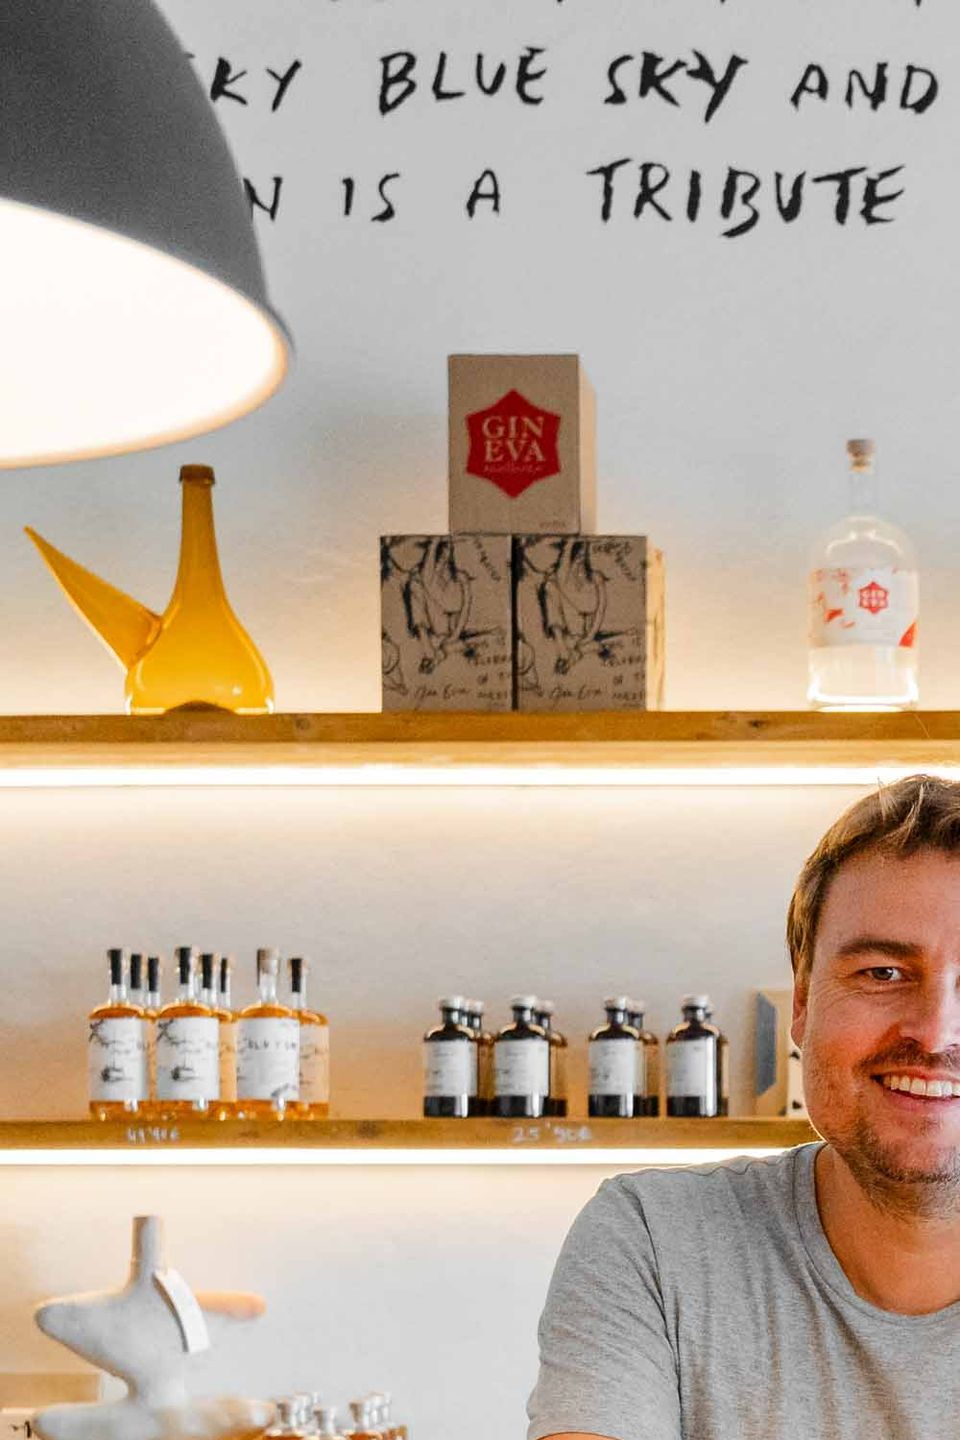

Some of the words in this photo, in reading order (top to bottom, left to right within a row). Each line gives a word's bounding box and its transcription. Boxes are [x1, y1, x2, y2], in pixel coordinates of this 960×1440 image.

[190, 54, 302, 113] KY
[379, 47, 546, 115] BLUE
[604, 50, 748, 122] SKY
[790, 62, 939, 114] AND
[342, 172, 400, 222] IS
[466, 169, 501, 218] A
[586, 158, 904, 238] TRIBUTE
[482, 416, 545, 439] GIN
[485, 439, 546, 463] EVA
